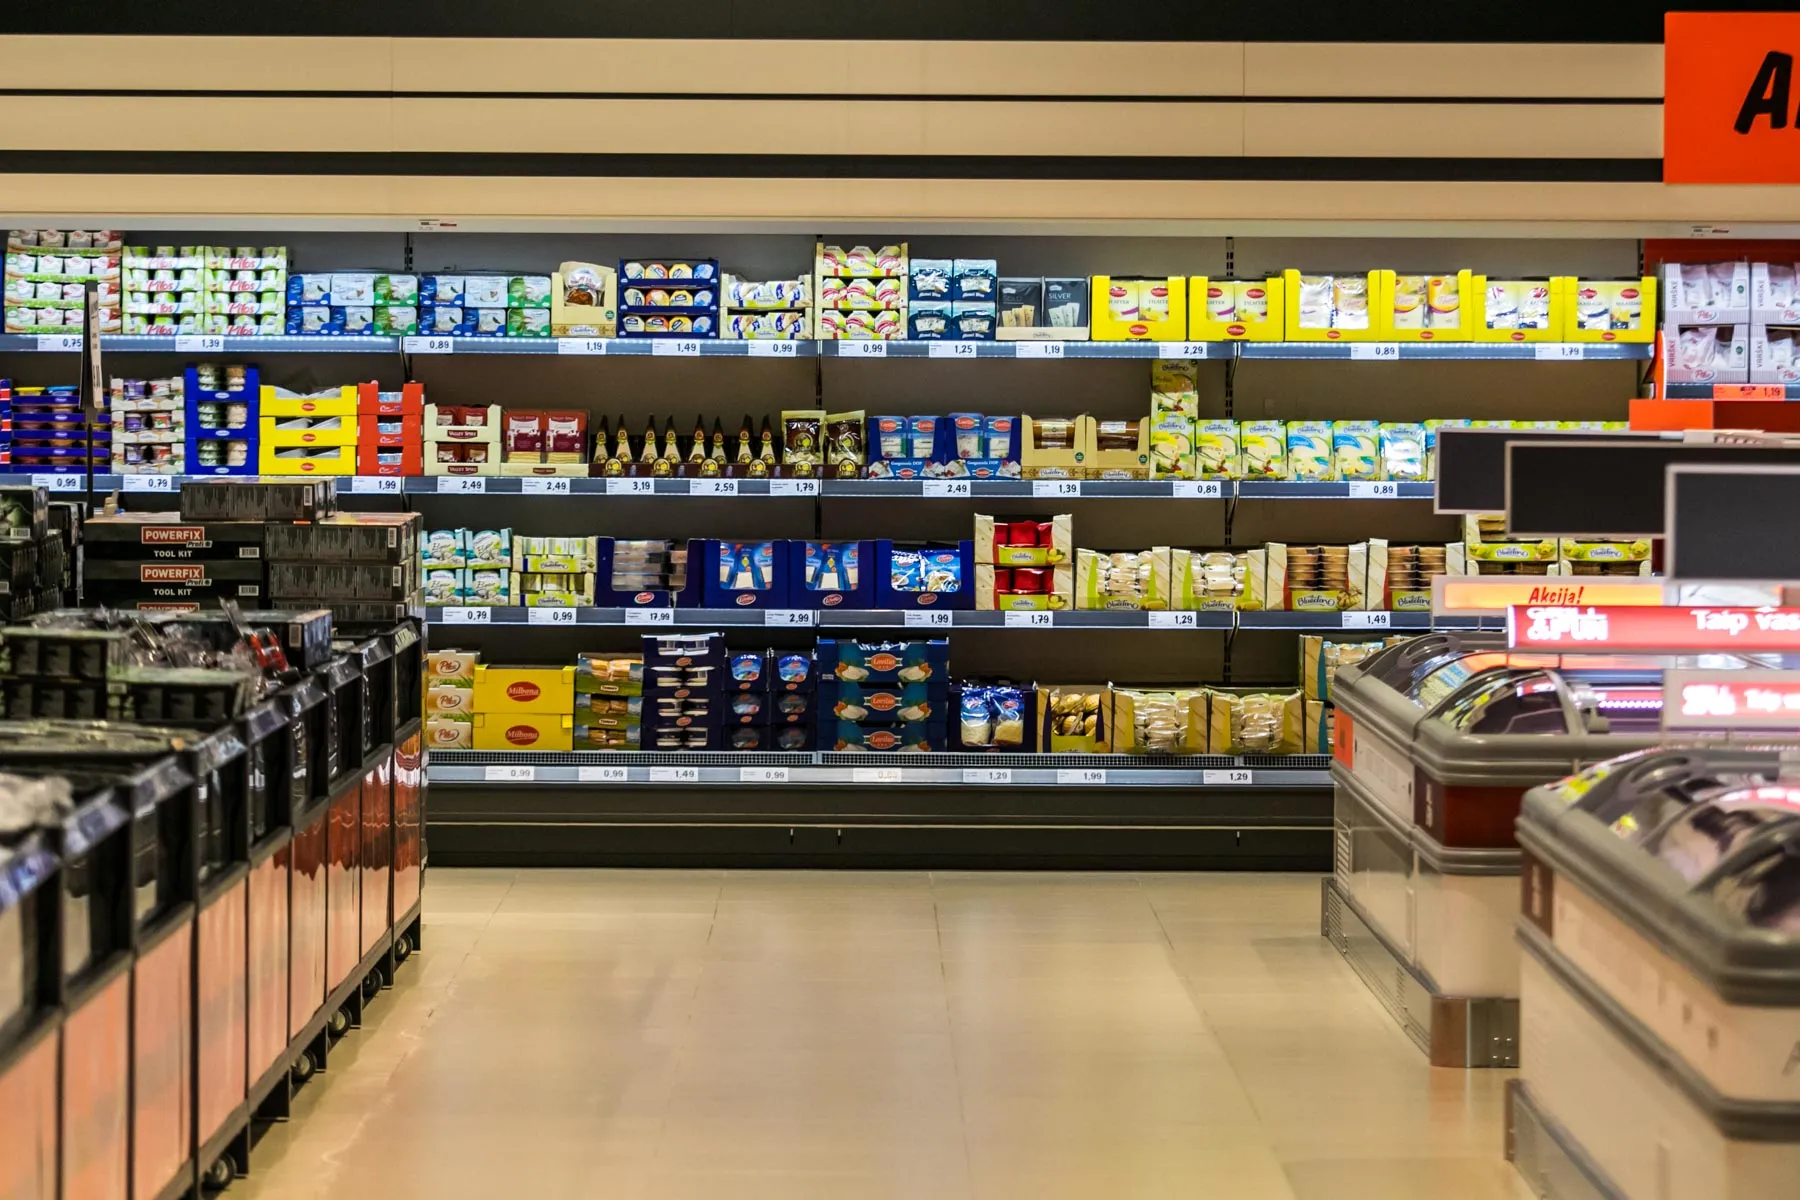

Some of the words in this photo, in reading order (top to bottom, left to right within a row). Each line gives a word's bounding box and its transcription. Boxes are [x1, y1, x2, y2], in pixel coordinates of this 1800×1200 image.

[1733, 50, 1800, 134] A
[1048, 292, 1072, 300] SILVER
[202, 338, 220, 349] 1,39
[429, 340, 450, 350] 0,89
[586, 341, 603, 352] 1,19
[677, 343, 697, 353] 1,49
[772, 343, 793, 353] 0,99
[863, 343, 883, 353] 0,99
[954, 344, 973, 355] 1,25
[1044, 345, 1061, 355] 1,19
[1183, 345, 1204, 355] 2,29
[1375, 346, 1395, 356] 0,89
[1561, 347, 1580, 356] 1,79
[56, 478, 77, 488] 0,99
[148, 478, 168, 488] 0,79
[378, 480, 397, 491] 1,99
[461, 480, 482, 490] 2,49
[546, 481, 567, 491] 2,49
[632, 481, 651, 492] 3,19
[714, 482, 735, 493] 2,59
[796, 482, 814, 493] 1,79
[1059, 483, 1077, 494] 1,39
[947, 484, 967, 494] 2,49
[1197, 484, 1217, 494] 0,89
[1373, 485, 1394, 495] 0,89
[145, 530, 201, 541] POWERFIX
[153, 550, 176, 558] TOOL
[178, 550, 193, 558] KIT
[144, 568, 201, 579] POWERFIX
[153, 588, 176, 596] TOOL
[178, 588, 192, 596] KIT
[1528, 586, 1585, 606] Akcija!
[467, 610, 487, 621] 0,79
[552, 611, 573, 622] 0,99
[789, 613, 809, 624] 2,99
[930, 613, 949, 625] 1,99
[1031, 614, 1050, 625] 1,79
[1175, 614, 1193, 625] 1,29
[1367, 614, 1387, 625] 1,49
[509, 686, 540, 697] Milbona
[507, 731, 538, 740] Milbona
